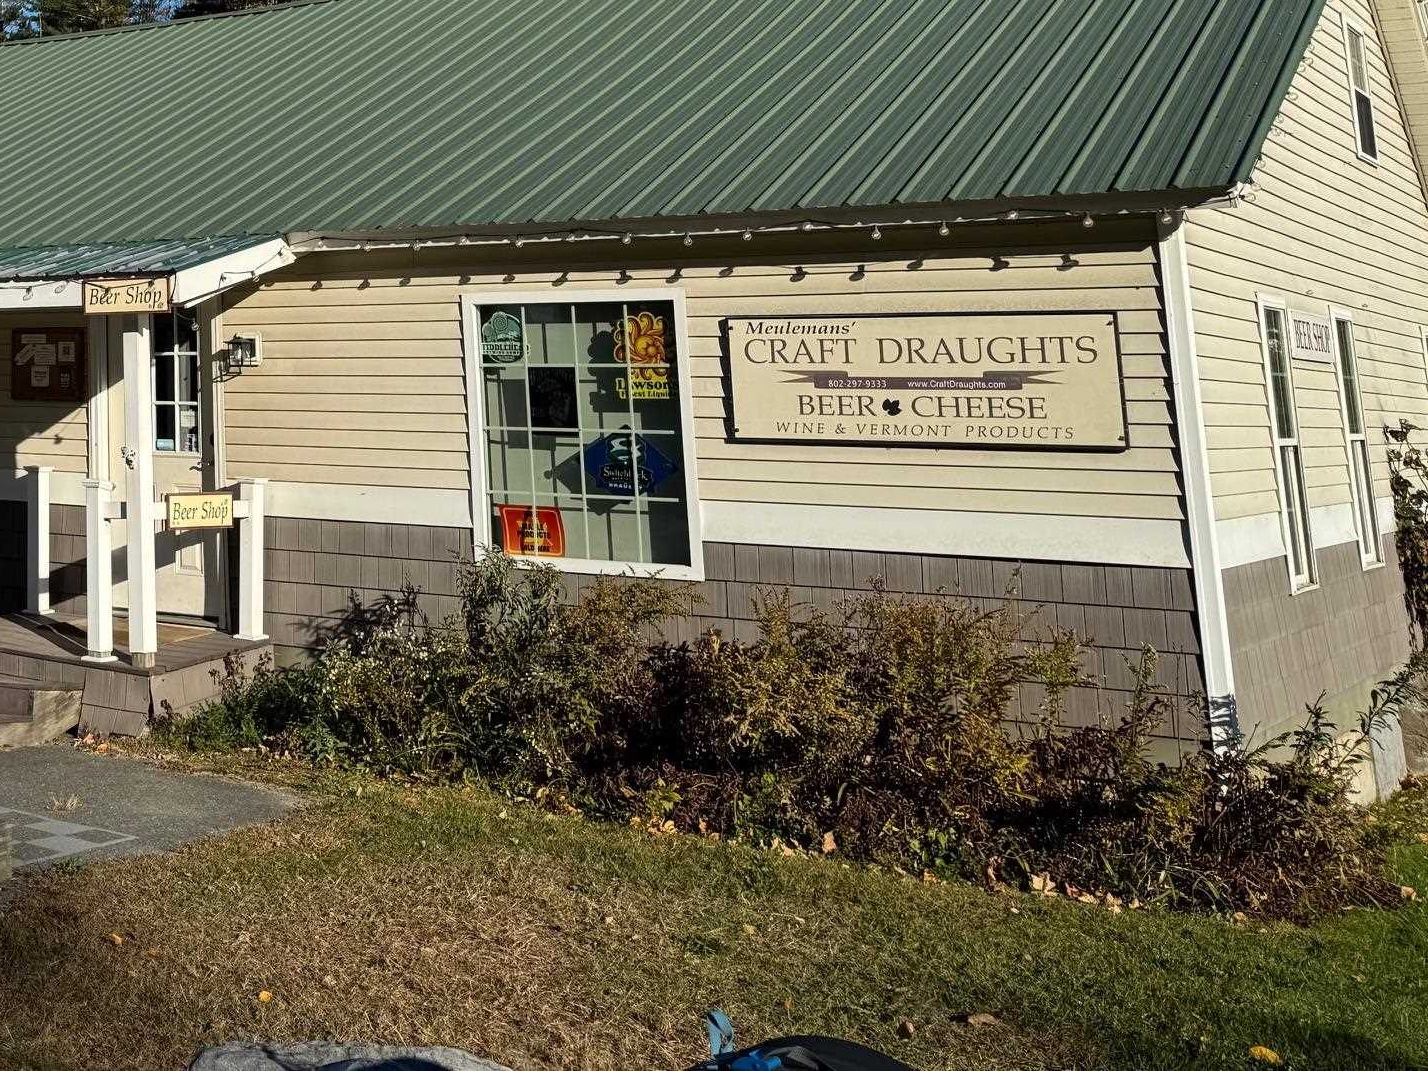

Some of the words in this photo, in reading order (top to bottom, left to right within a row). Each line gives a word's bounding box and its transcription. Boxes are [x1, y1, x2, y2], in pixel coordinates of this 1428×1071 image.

[89, 288, 121, 306] Beer
[125, 286, 163, 310] Shop
[745, 321, 856, 335] Meulemans'
[1294, 319, 1313, 350] BEER
[1313, 323, 1331, 353] SHOP
[744, 338, 857, 364] CRAFT
[876, 336, 1098, 365] DRAUGHTS
[828, 379, 887, 388] 802-297-9333
[907, 380, 1007, 390] www.CraftDraughts.com
[797, 394, 877, 417] BEER
[911, 396, 1048, 419] CHEESE
[776, 422, 825, 434] WINE
[835, 423, 846, 435] &
[856, 423, 952, 437] VERMONT
[965, 425, 1075, 440] PRODUCTS
[173, 502, 198, 520] Beer
[201, 501, 228, 524] Shop
